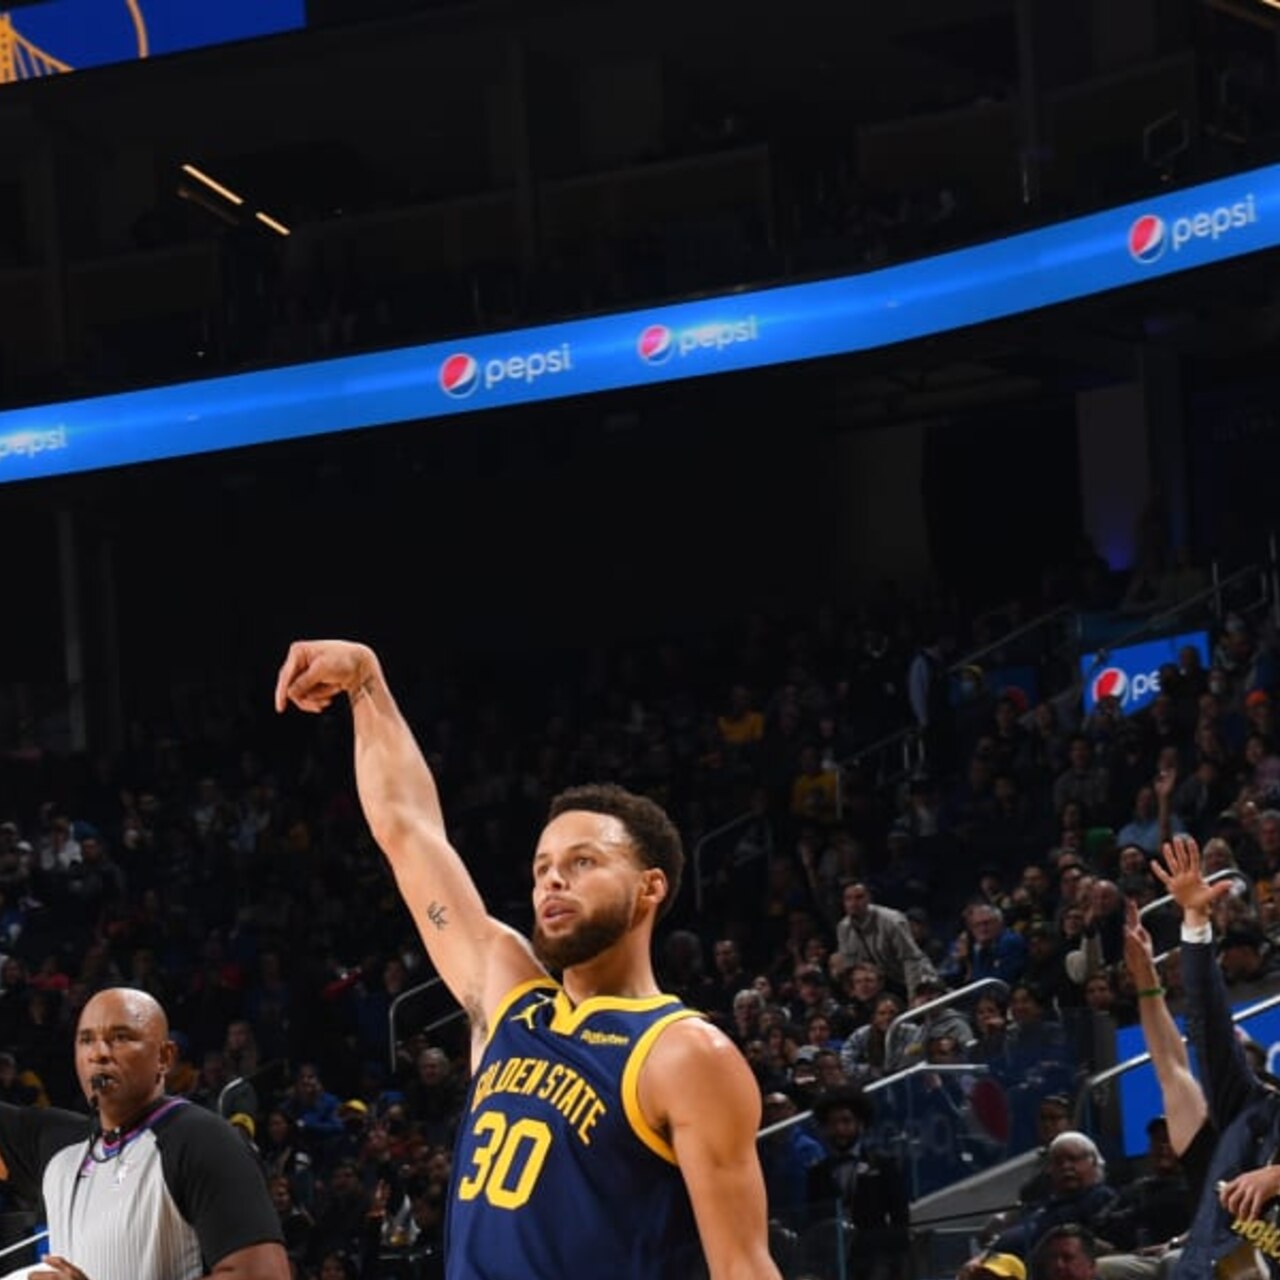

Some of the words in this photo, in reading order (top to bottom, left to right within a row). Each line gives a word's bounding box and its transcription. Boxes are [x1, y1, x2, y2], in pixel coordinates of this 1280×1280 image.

[1171, 194, 1257, 252] pepsi
[677, 315, 759, 358] pepsi
[483, 343, 573, 390] pepsi
[538, 1062, 607, 1146] STATE
[459, 1110, 554, 1210] 30
